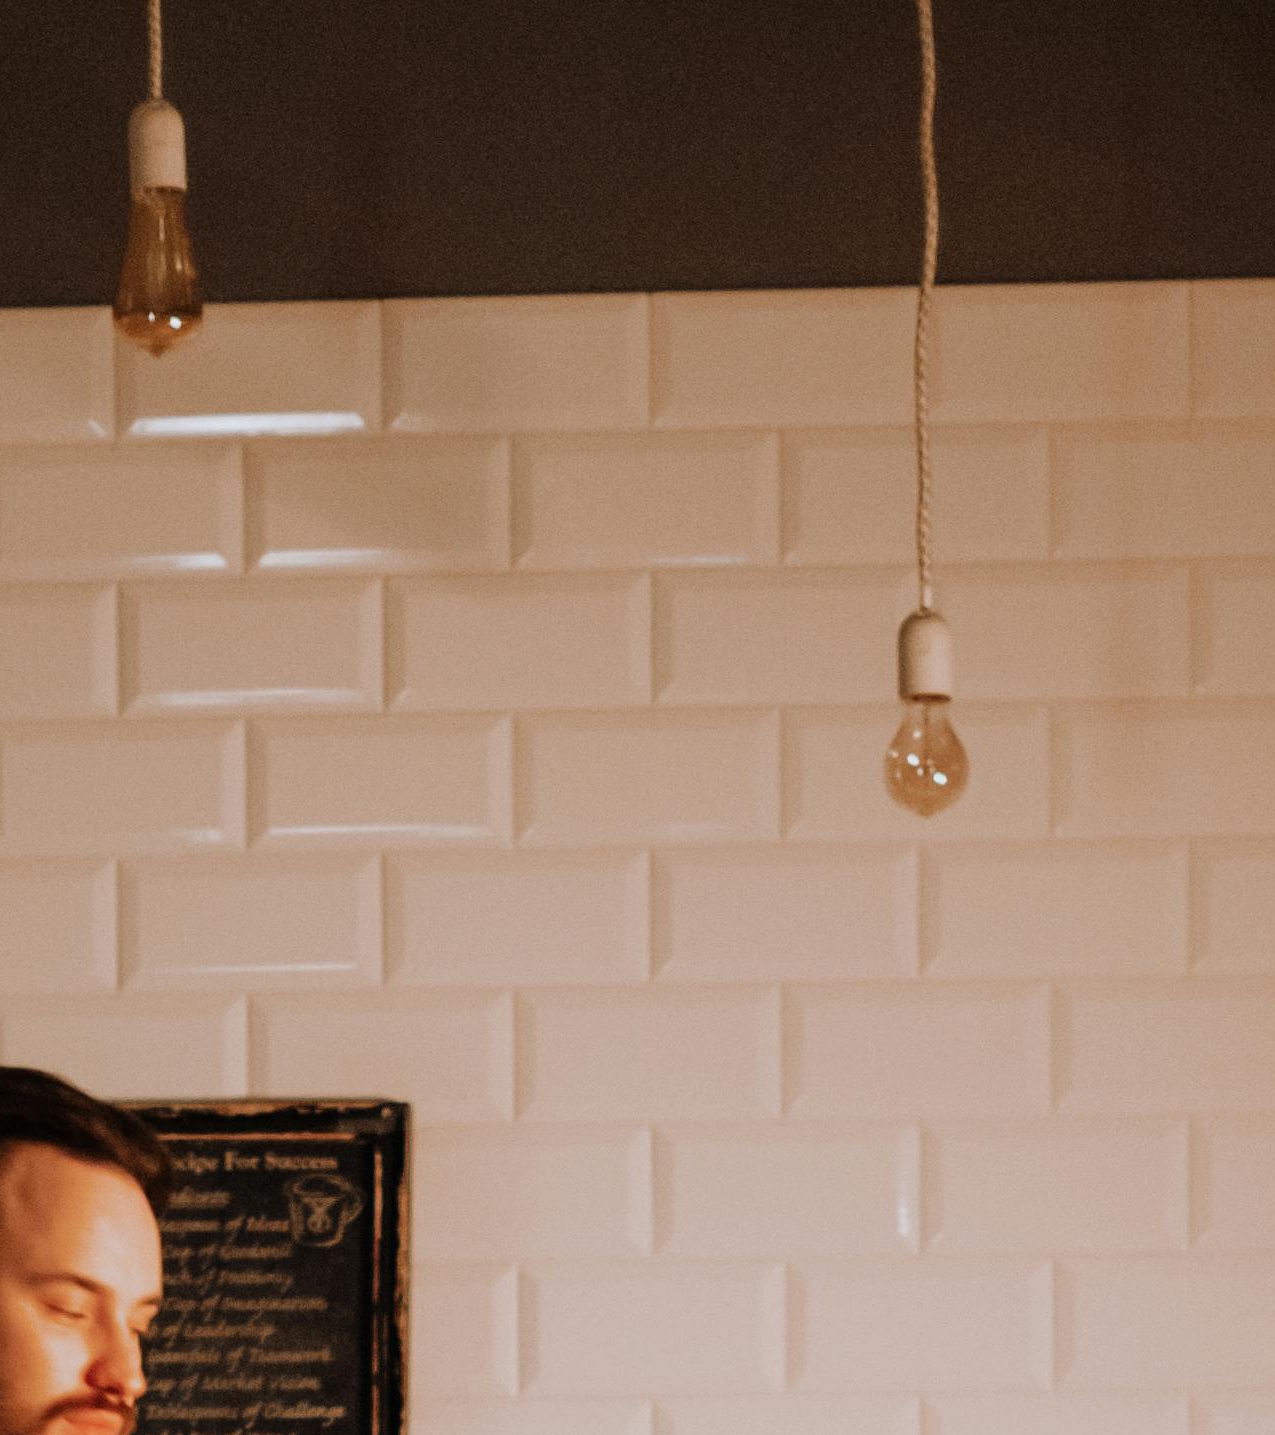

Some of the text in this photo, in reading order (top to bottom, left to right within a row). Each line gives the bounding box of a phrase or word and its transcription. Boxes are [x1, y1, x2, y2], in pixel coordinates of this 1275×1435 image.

[173, 1151, 338, 1174] cipe For Success
[262, 1401, 345, 1428] Challenge
